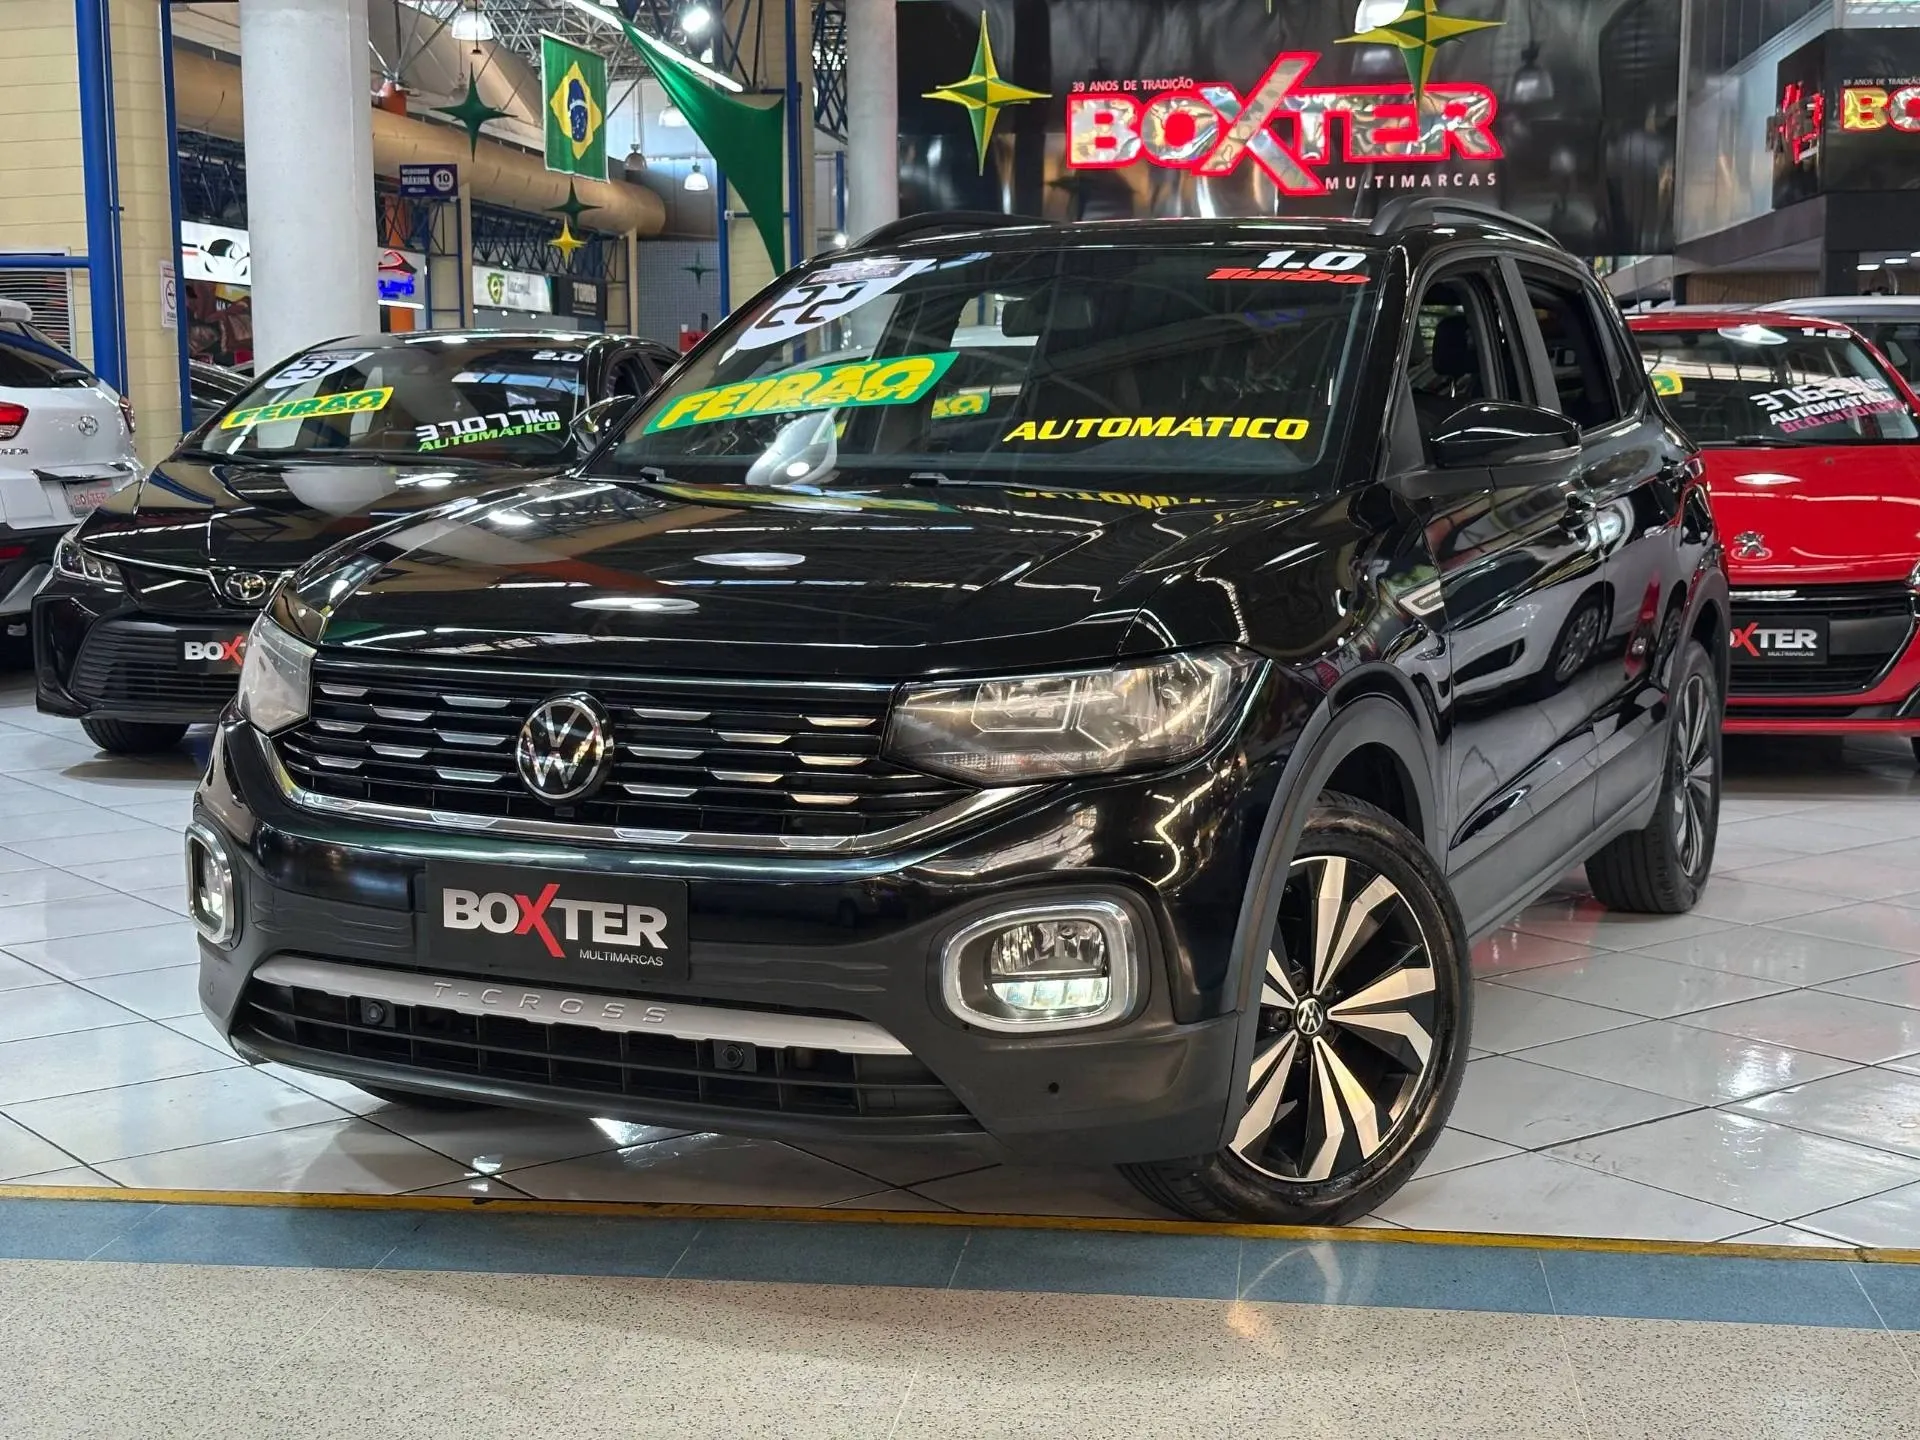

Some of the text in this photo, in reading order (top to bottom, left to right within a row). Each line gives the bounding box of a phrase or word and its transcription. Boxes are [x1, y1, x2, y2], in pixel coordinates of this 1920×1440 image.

[1072, 76, 1194, 92] 39 ANOS DE TRADIÇÃO
[1066, 51, 1503, 195] BOXTER
[437, 173, 451, 183] 10
[1257, 250, 1367, 271] 1.0
[754, 280, 868, 329] 22
[532, 351, 584, 362] 2.0
[275, 361, 336, 379] 23
[657, 358, 934, 428] FEIRÃO
[443, 883, 669, 958] BOXTER
[579, 948, 664, 967] MULTIMARCAS
[433, 982, 667, 1024] T-CROSS
